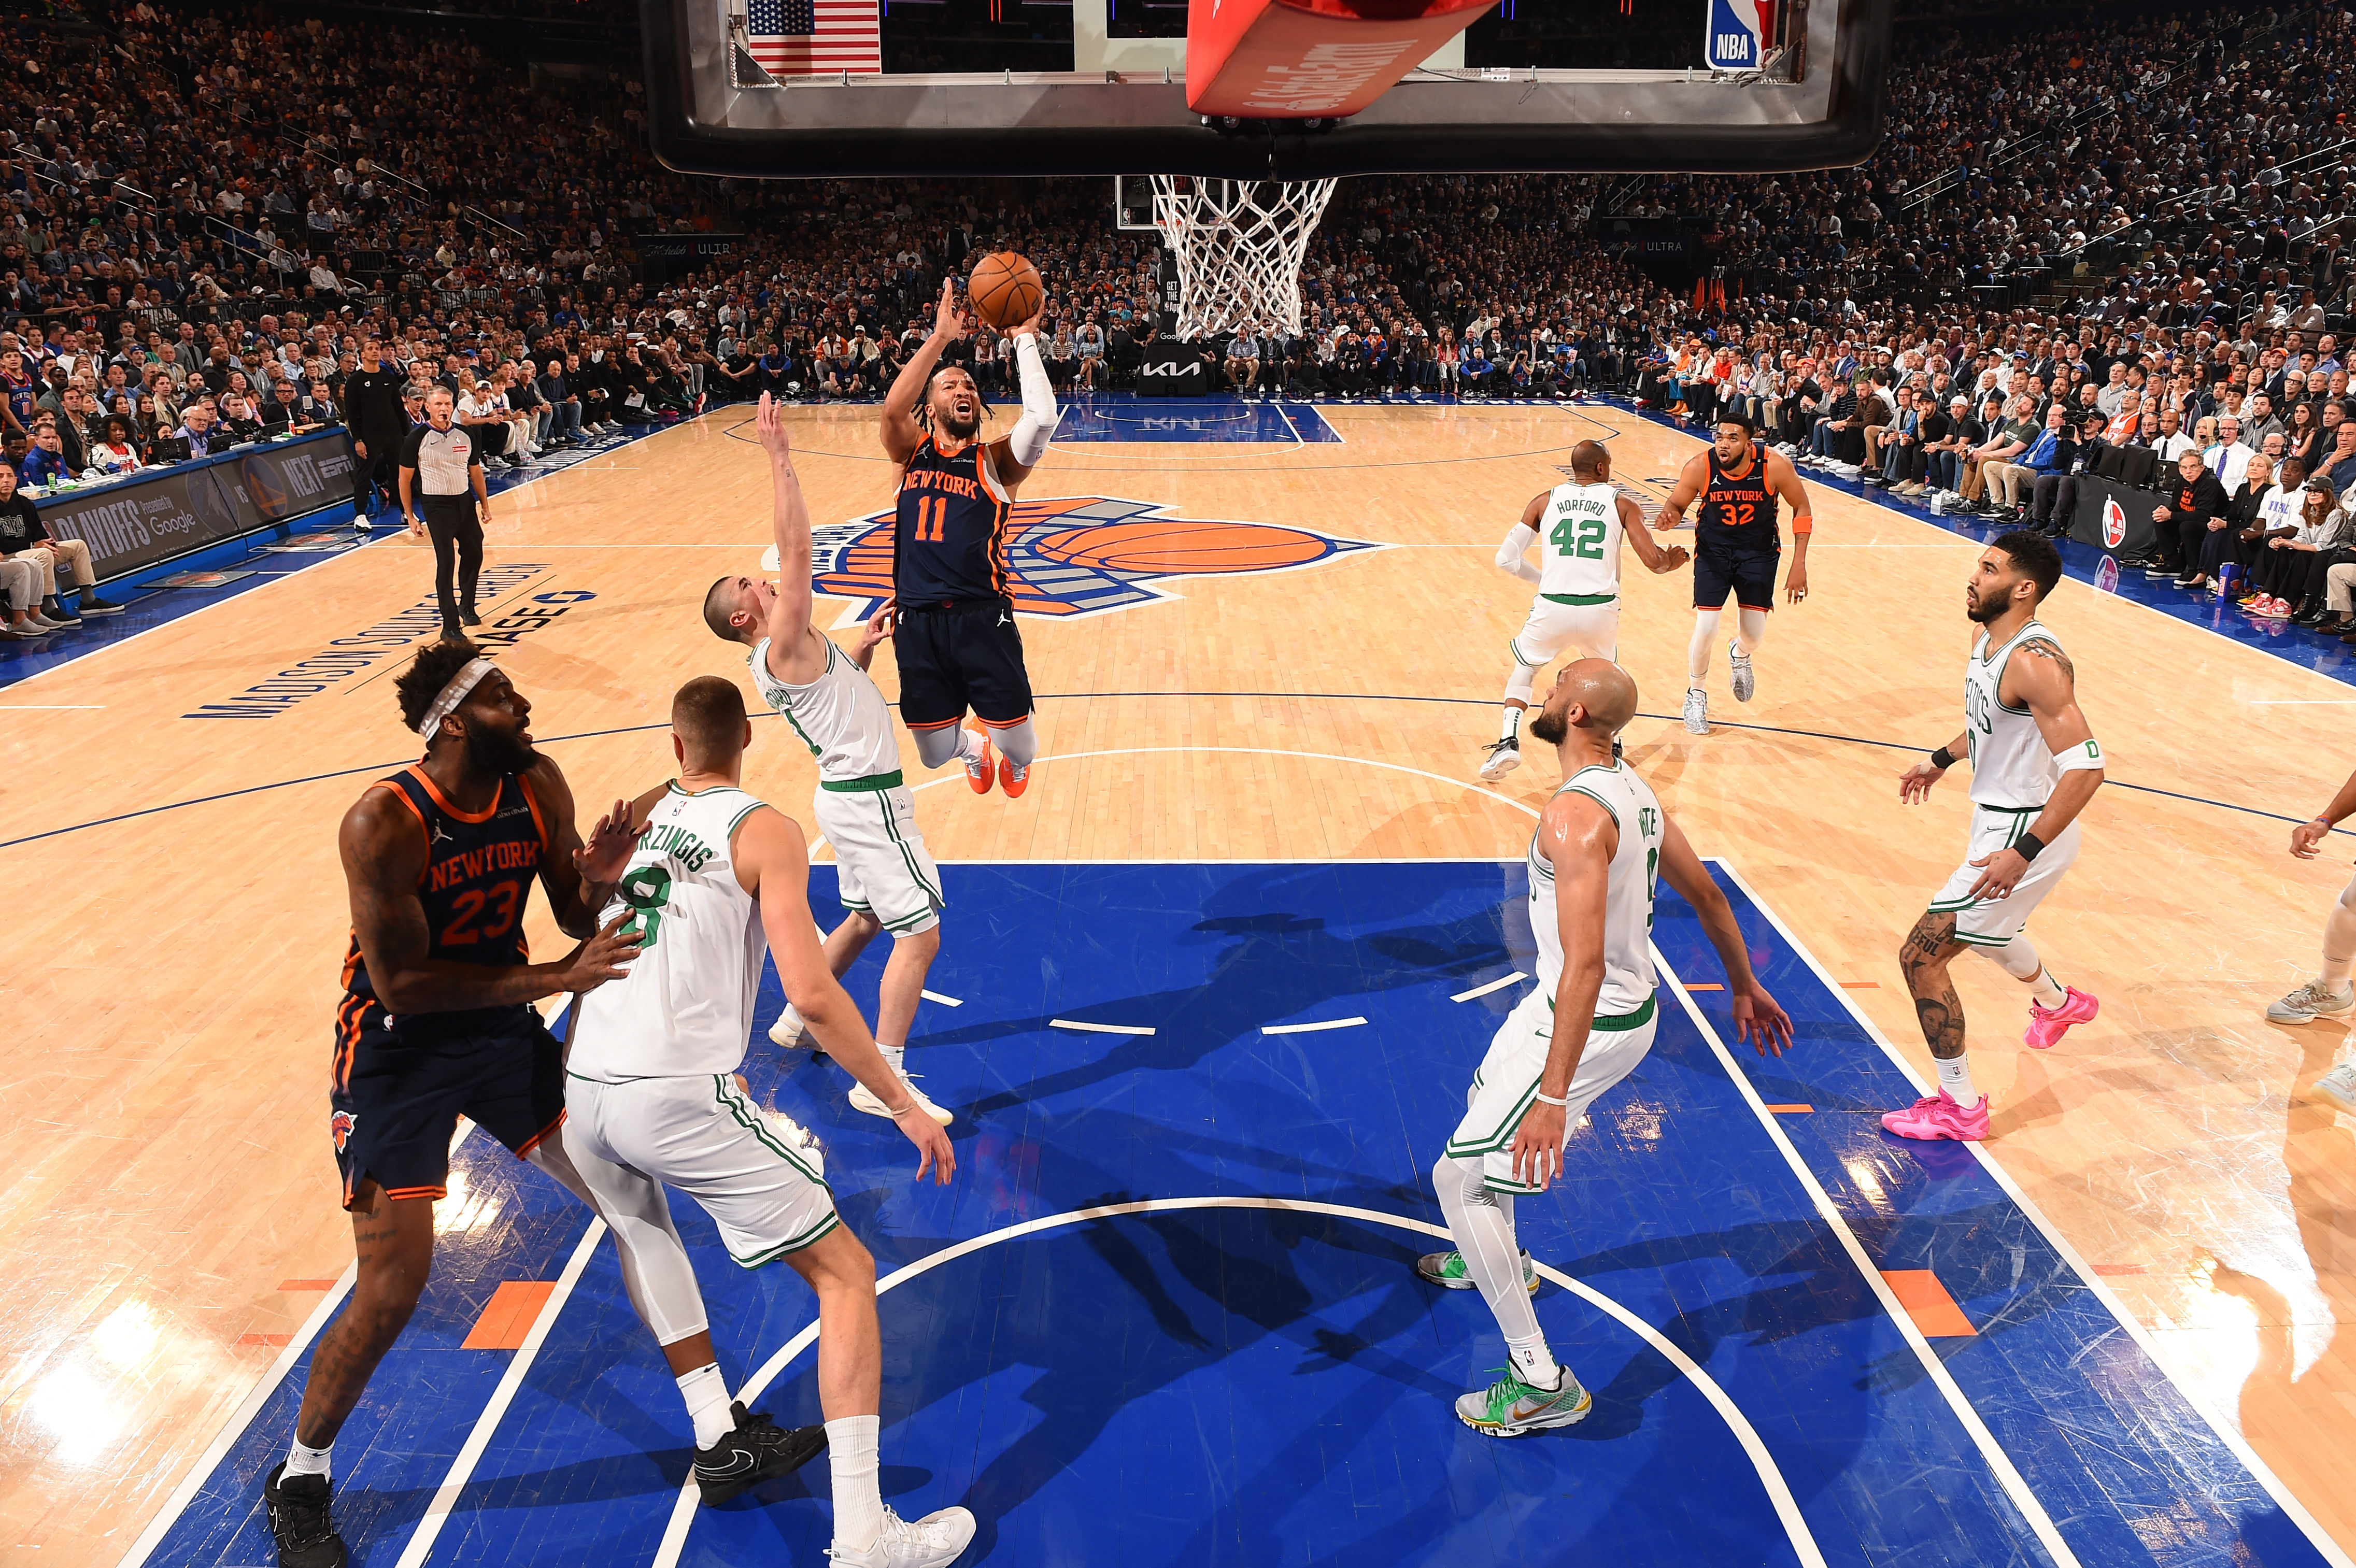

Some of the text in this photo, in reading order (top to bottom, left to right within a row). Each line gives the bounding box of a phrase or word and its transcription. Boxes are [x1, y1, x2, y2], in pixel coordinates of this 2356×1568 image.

[1716, 34, 1748, 60] NBA
[698, 243, 730, 255] ULTR
[1647, 241, 1683, 252] ULTRA
[1166, 280, 1178, 291] GET
[1167, 291, 1178, 301] THE
[1160, 332, 1181, 342] Goog
[1143, 362, 1200, 377] KIA
[281, 454, 325, 498] NEXT
[318, 454, 354, 479] ESPN
[903, 469, 977, 501] NEW YORK
[1709, 490, 1764, 502] NEW YORK
[914, 495, 948, 543] 11
[1556, 499, 1606, 517] HORFORD
[1720, 504, 1755, 526] 32
[55, 499, 151, 563] PLAYOFFS
[150, 509, 196, 535] Google
[1550, 518, 1607, 560] 42
[180, 650, 392, 719] MADISON
[1965, 677, 1993, 735] ELTICS
[2085, 740, 2099, 759] 0
[634, 824, 713, 873] RZINGIS
[430, 840, 542, 893] NEW YORK
[441, 878, 521, 947] 23
[619, 866, 672, 950] 8
